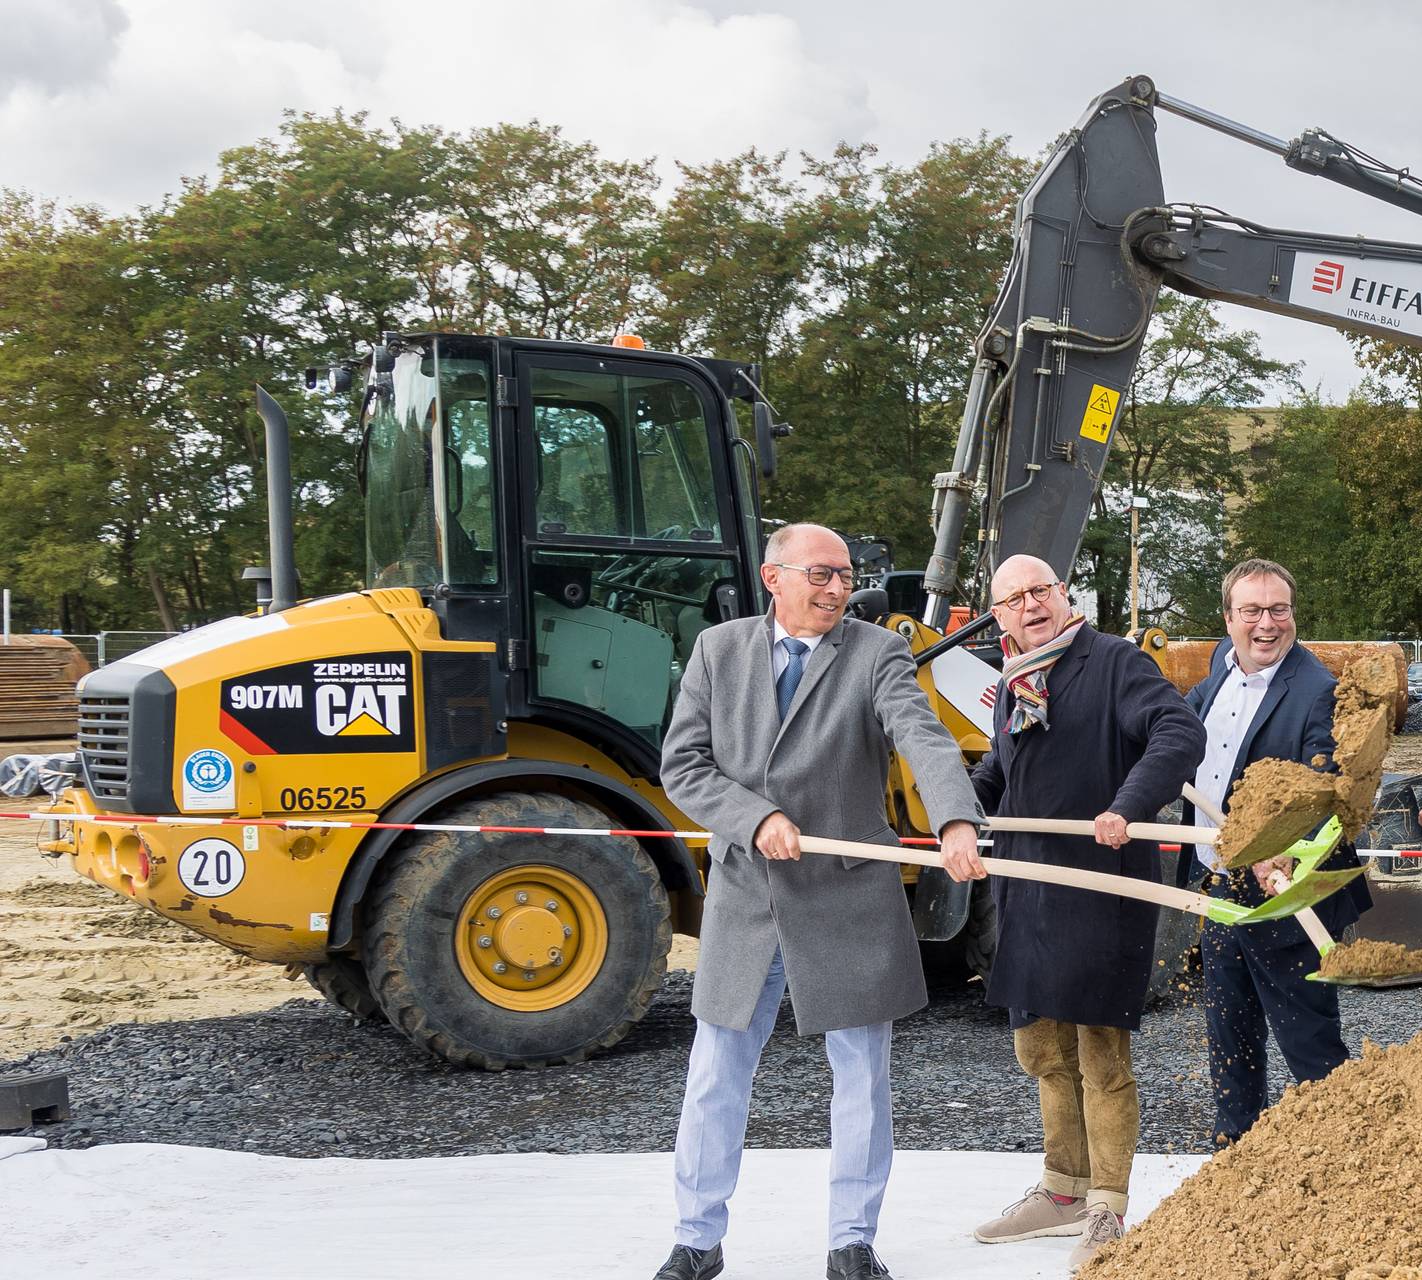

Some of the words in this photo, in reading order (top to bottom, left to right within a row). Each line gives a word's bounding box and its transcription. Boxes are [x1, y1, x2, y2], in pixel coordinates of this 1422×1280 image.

[1347, 308, 1400, 328] INFRA-BAU
[313, 663, 406, 676] ZEPPELIN
[230, 685, 303, 709] 907M
[315, 684, 407, 736] CAT
[280, 786, 367, 810] 06525
[193, 850, 231, 885] 20
